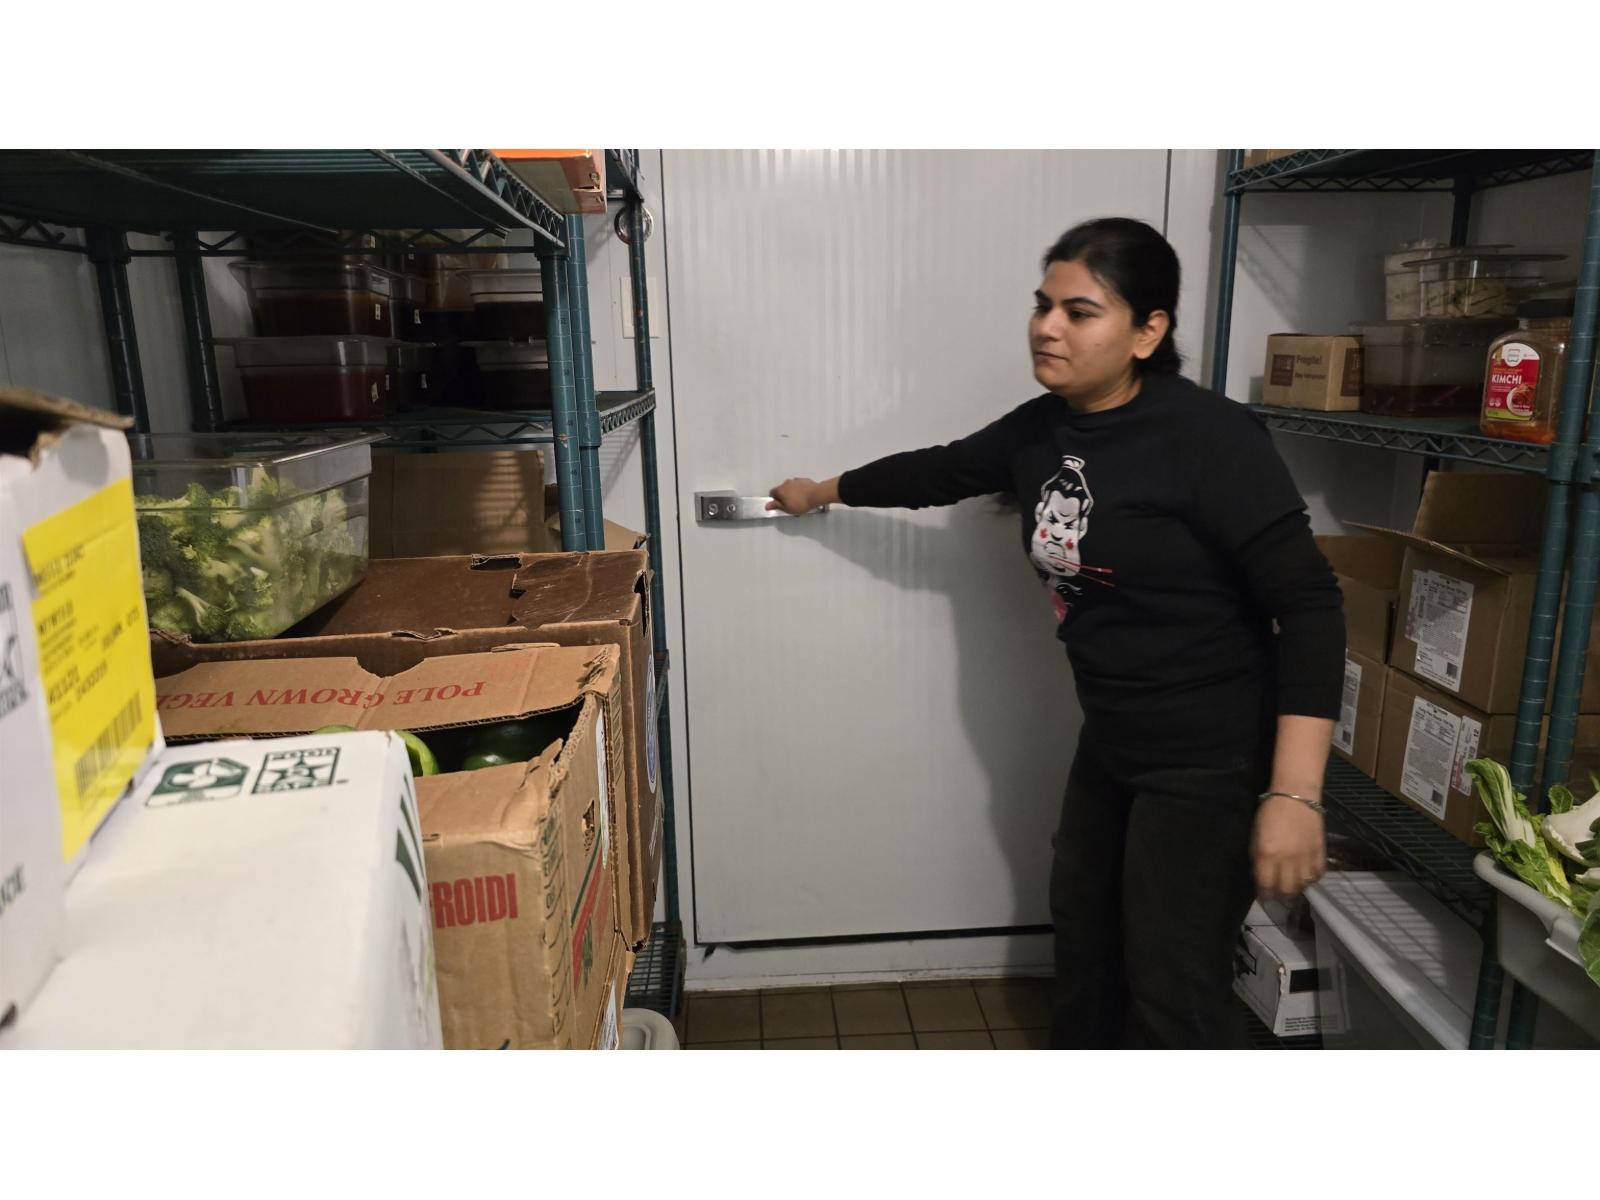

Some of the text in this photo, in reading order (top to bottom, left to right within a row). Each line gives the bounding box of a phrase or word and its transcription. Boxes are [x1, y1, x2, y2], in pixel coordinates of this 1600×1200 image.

[1491, 374, 1522, 385] KIMCHI
[247, 688, 384, 709] GROWN
[393, 681, 486, 705] POLE
[428, 872, 519, 928] ROIDI
